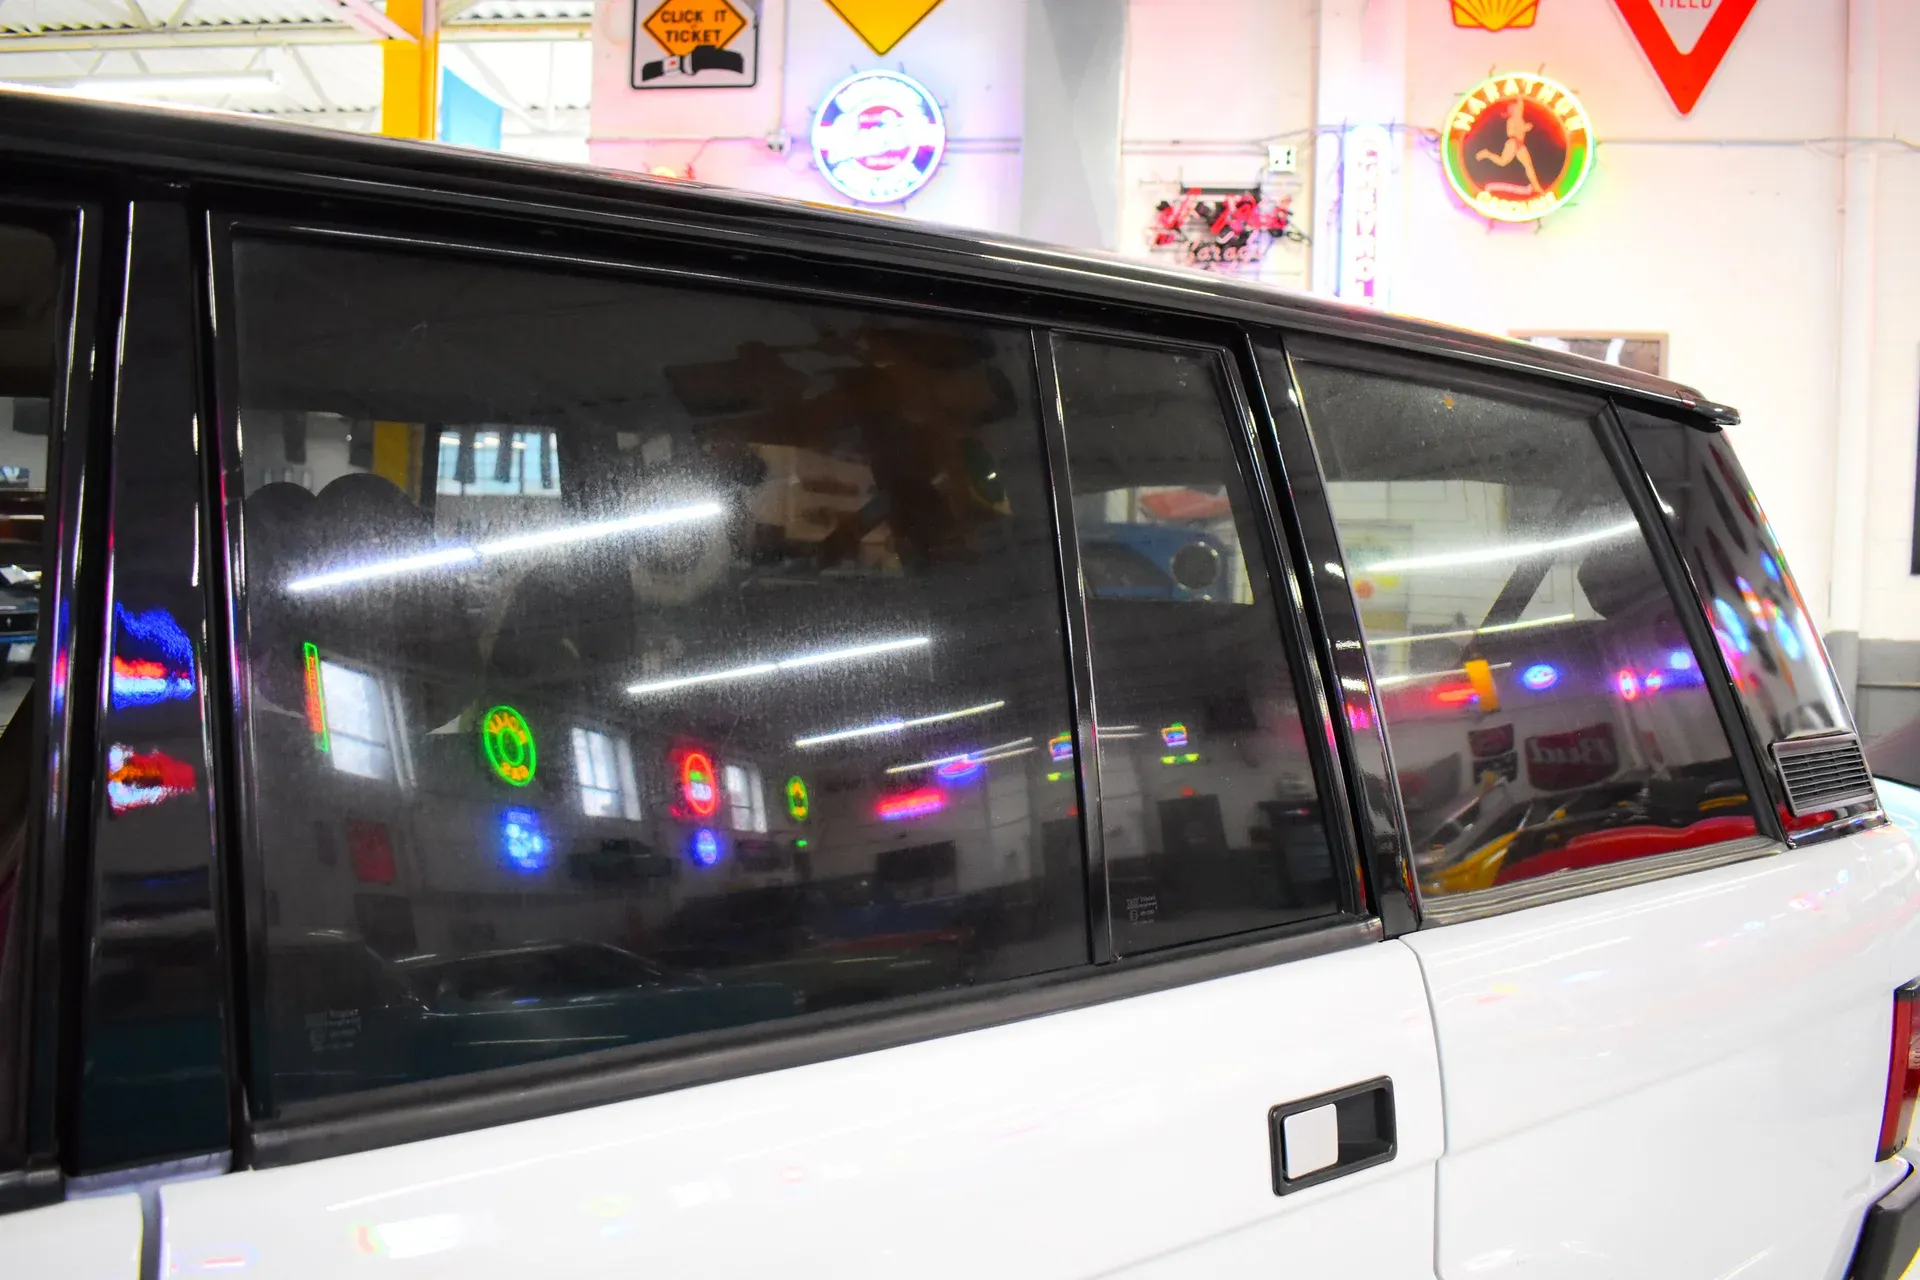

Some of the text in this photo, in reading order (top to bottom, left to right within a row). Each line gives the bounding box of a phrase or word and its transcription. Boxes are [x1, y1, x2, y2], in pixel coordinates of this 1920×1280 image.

[661, 9, 727, 23] CLICK IT
[665, 30, 721, 42] TICKET
[1451, 78, 1586, 132] MARATHON
